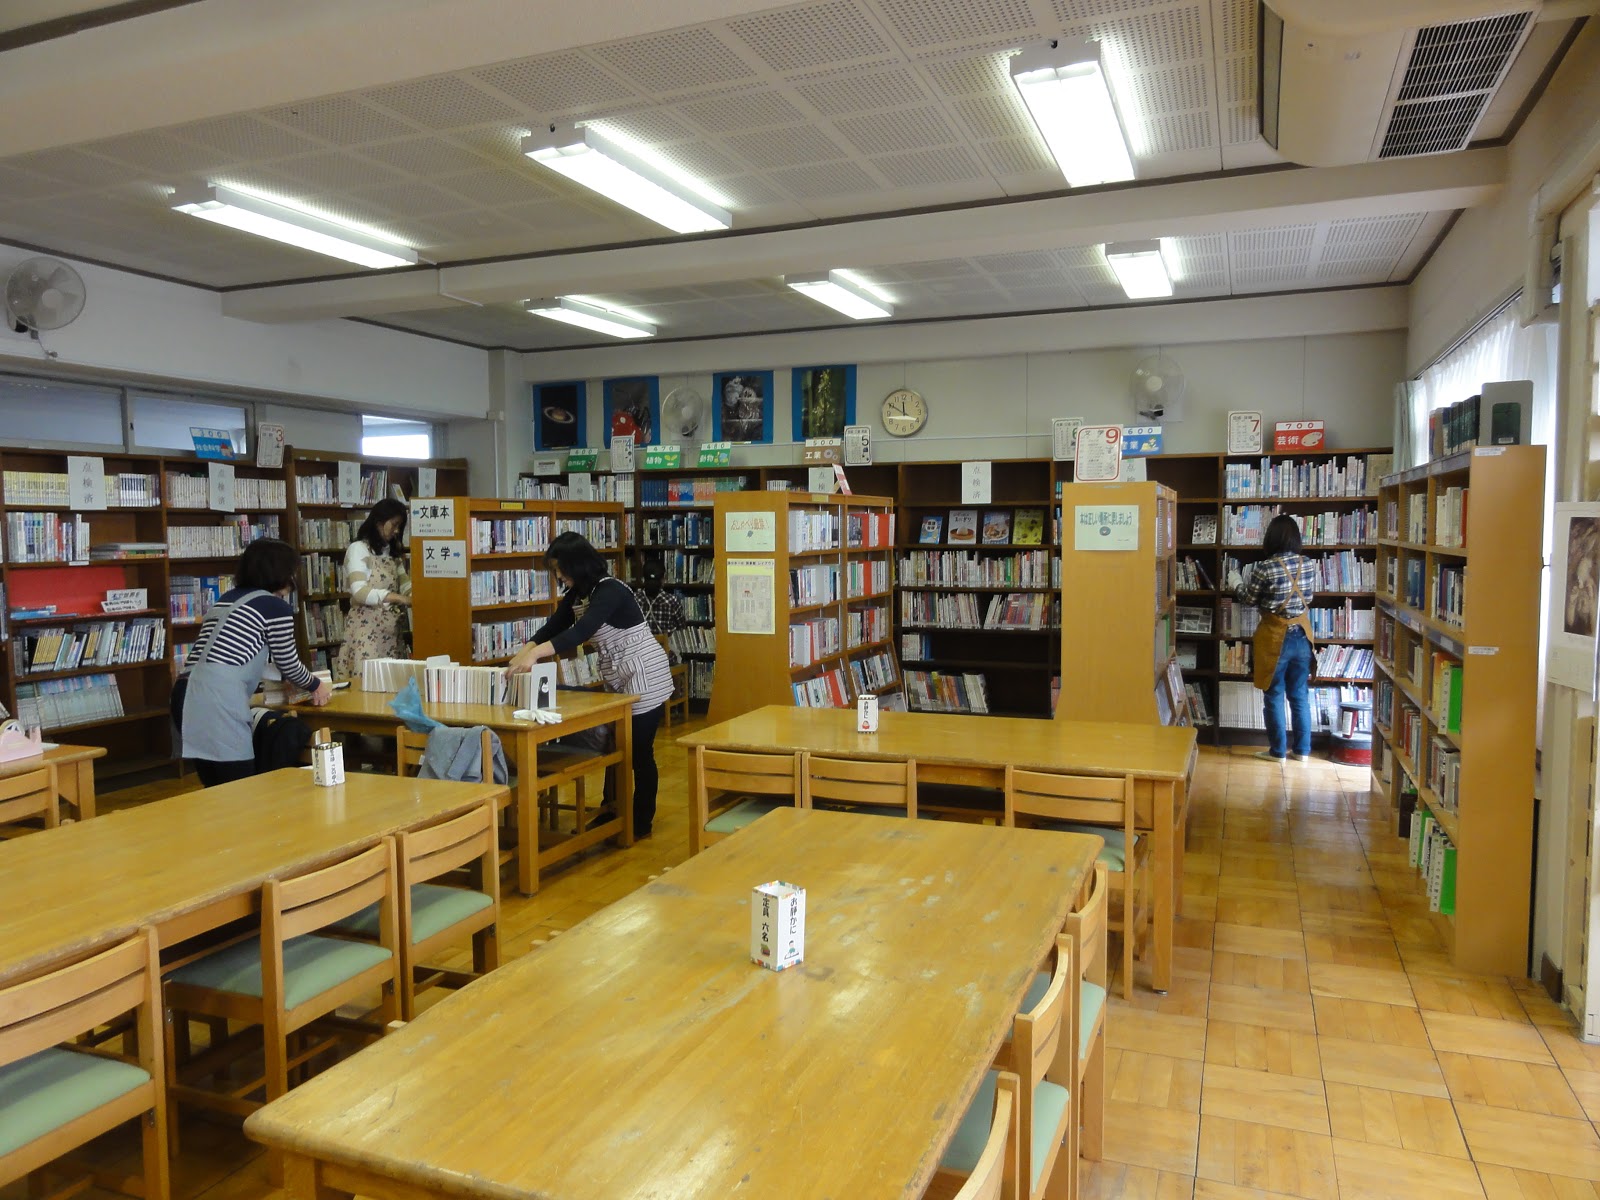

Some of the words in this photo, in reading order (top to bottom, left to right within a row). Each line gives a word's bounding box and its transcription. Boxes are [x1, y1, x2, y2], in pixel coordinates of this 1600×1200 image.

[1250, 420, 1259, 432] 7
[201, 429, 222, 438] 300
[276, 429, 283, 442] 3
[1106, 428, 1119, 444] 9
[625, 438, 632, 449] 4
[862, 435, 869, 446] 5
[1277, 435, 1299, 445] 芸術
[646, 456, 662, 465] 植物
[700, 454, 714, 462] 動物
[805, 451, 821, 459] 工業
[420, 505, 450, 519] 文庫本
[426, 546, 450, 561] 文学
[790, 897, 798, 935] お静かに
[762, 922, 769, 943] 六名
